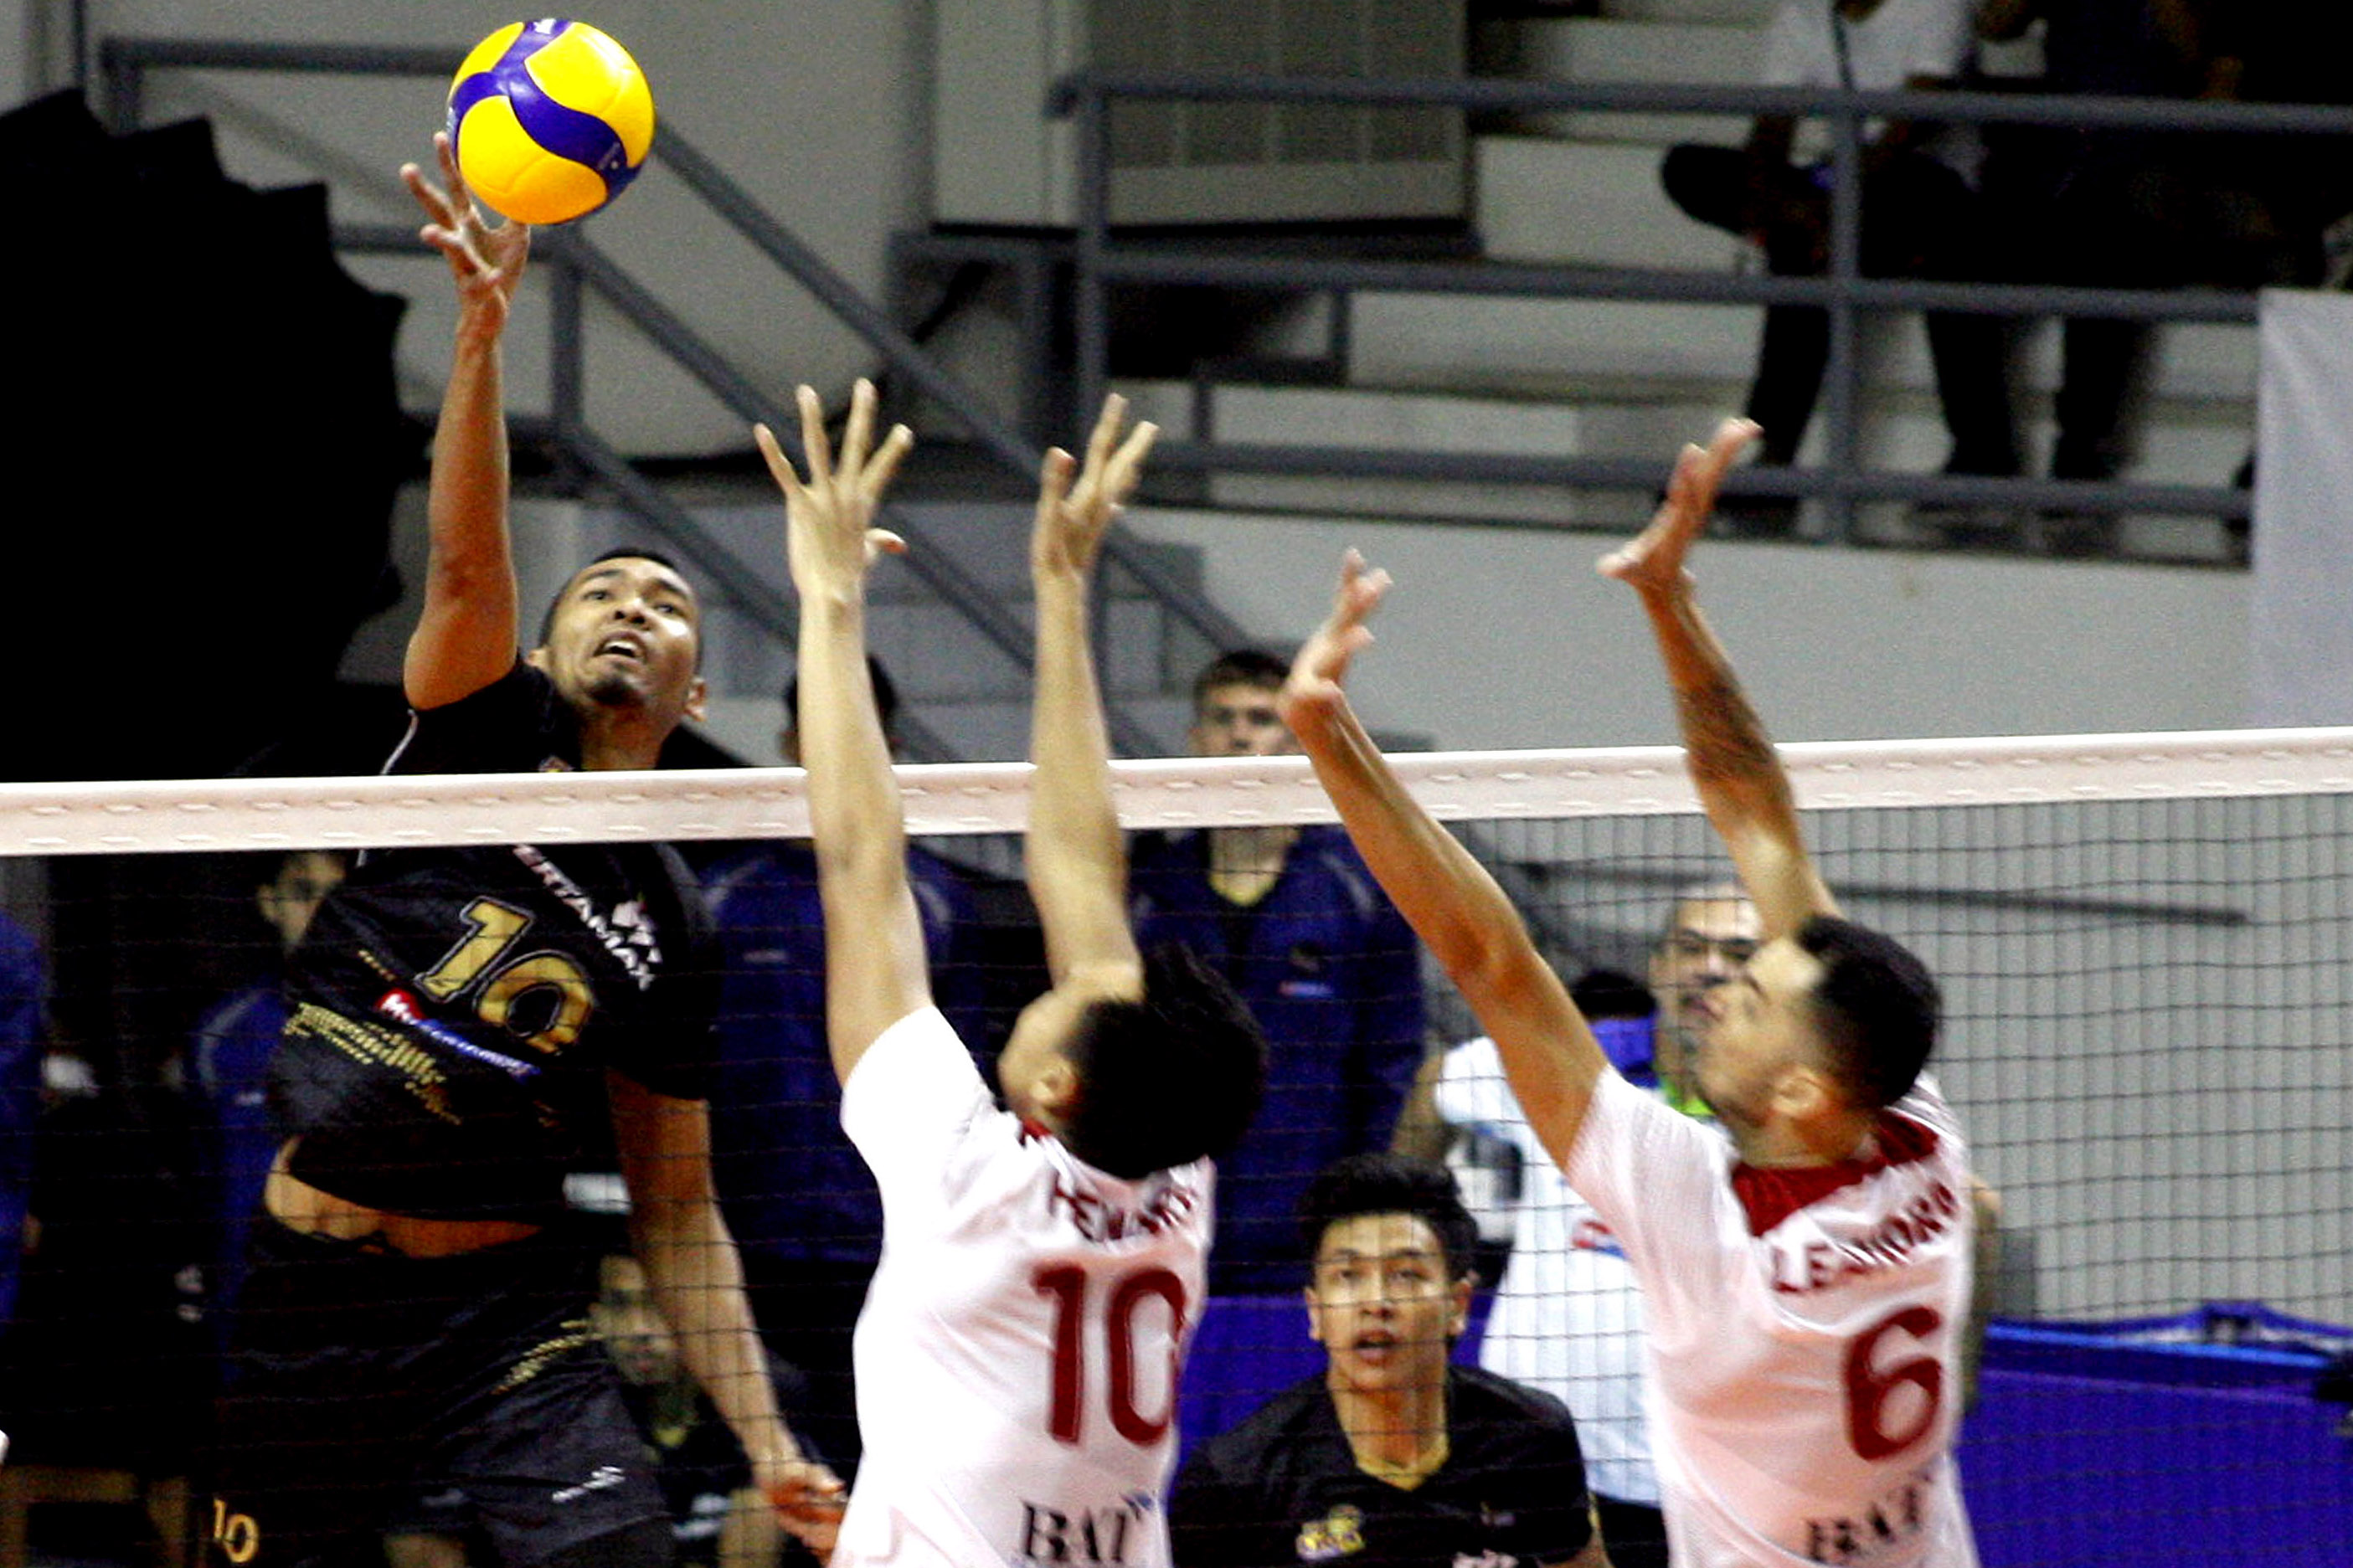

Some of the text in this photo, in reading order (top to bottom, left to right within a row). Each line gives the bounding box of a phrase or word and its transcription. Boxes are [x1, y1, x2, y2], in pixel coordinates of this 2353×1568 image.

[414, 894, 600, 1057] 10
[1029, 1262, 1187, 1447] 10
[1846, 1306, 1944, 1463] 6
[213, 1497, 260, 1563] 10
